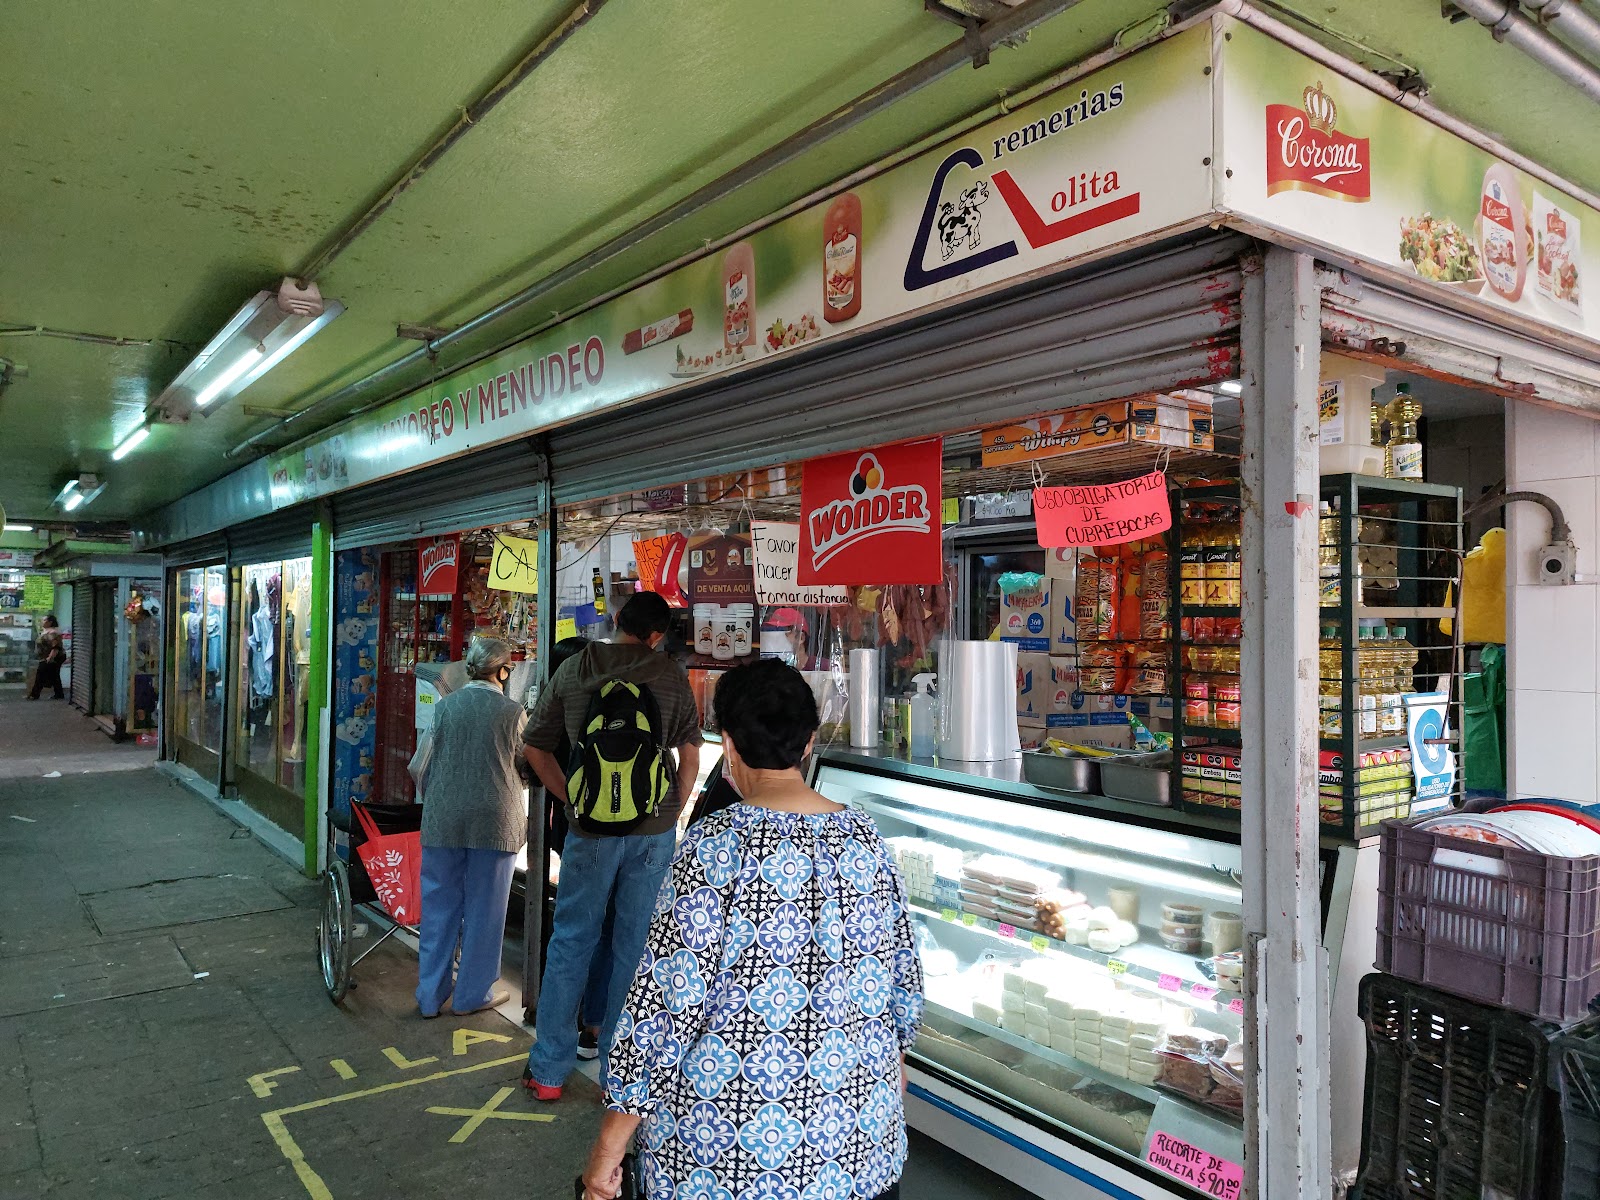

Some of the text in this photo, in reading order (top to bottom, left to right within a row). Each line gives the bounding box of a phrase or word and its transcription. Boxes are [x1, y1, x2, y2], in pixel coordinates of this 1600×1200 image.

[1277, 116, 1363, 183] Corona
[458, 388, 473, 430] Y
[478, 335, 605, 425] MENUDEO
[1320, 385, 1338, 402] stal
[1063, 473, 1164, 506] OBLIGATORIO
[811, 490, 924, 548] WONDER
[1065, 511, 1163, 544] CUBREBOCAS
[1080, 506, 1109, 522] DE
[752, 527, 798, 554] Favor
[422, 541, 456, 574] WONDER
[756, 556, 793, 580] hacer
[697, 582, 751, 594] DE VENTA AQUÍ
[757, 584, 801, 604] tomar
[1182, 766, 1198, 774] mbasa
[246, 1028, 514, 1098] FILA
[1149, 1151, 1194, 1181] CHULETA
[1157, 1133, 1224, 1172] RECORTE DE
